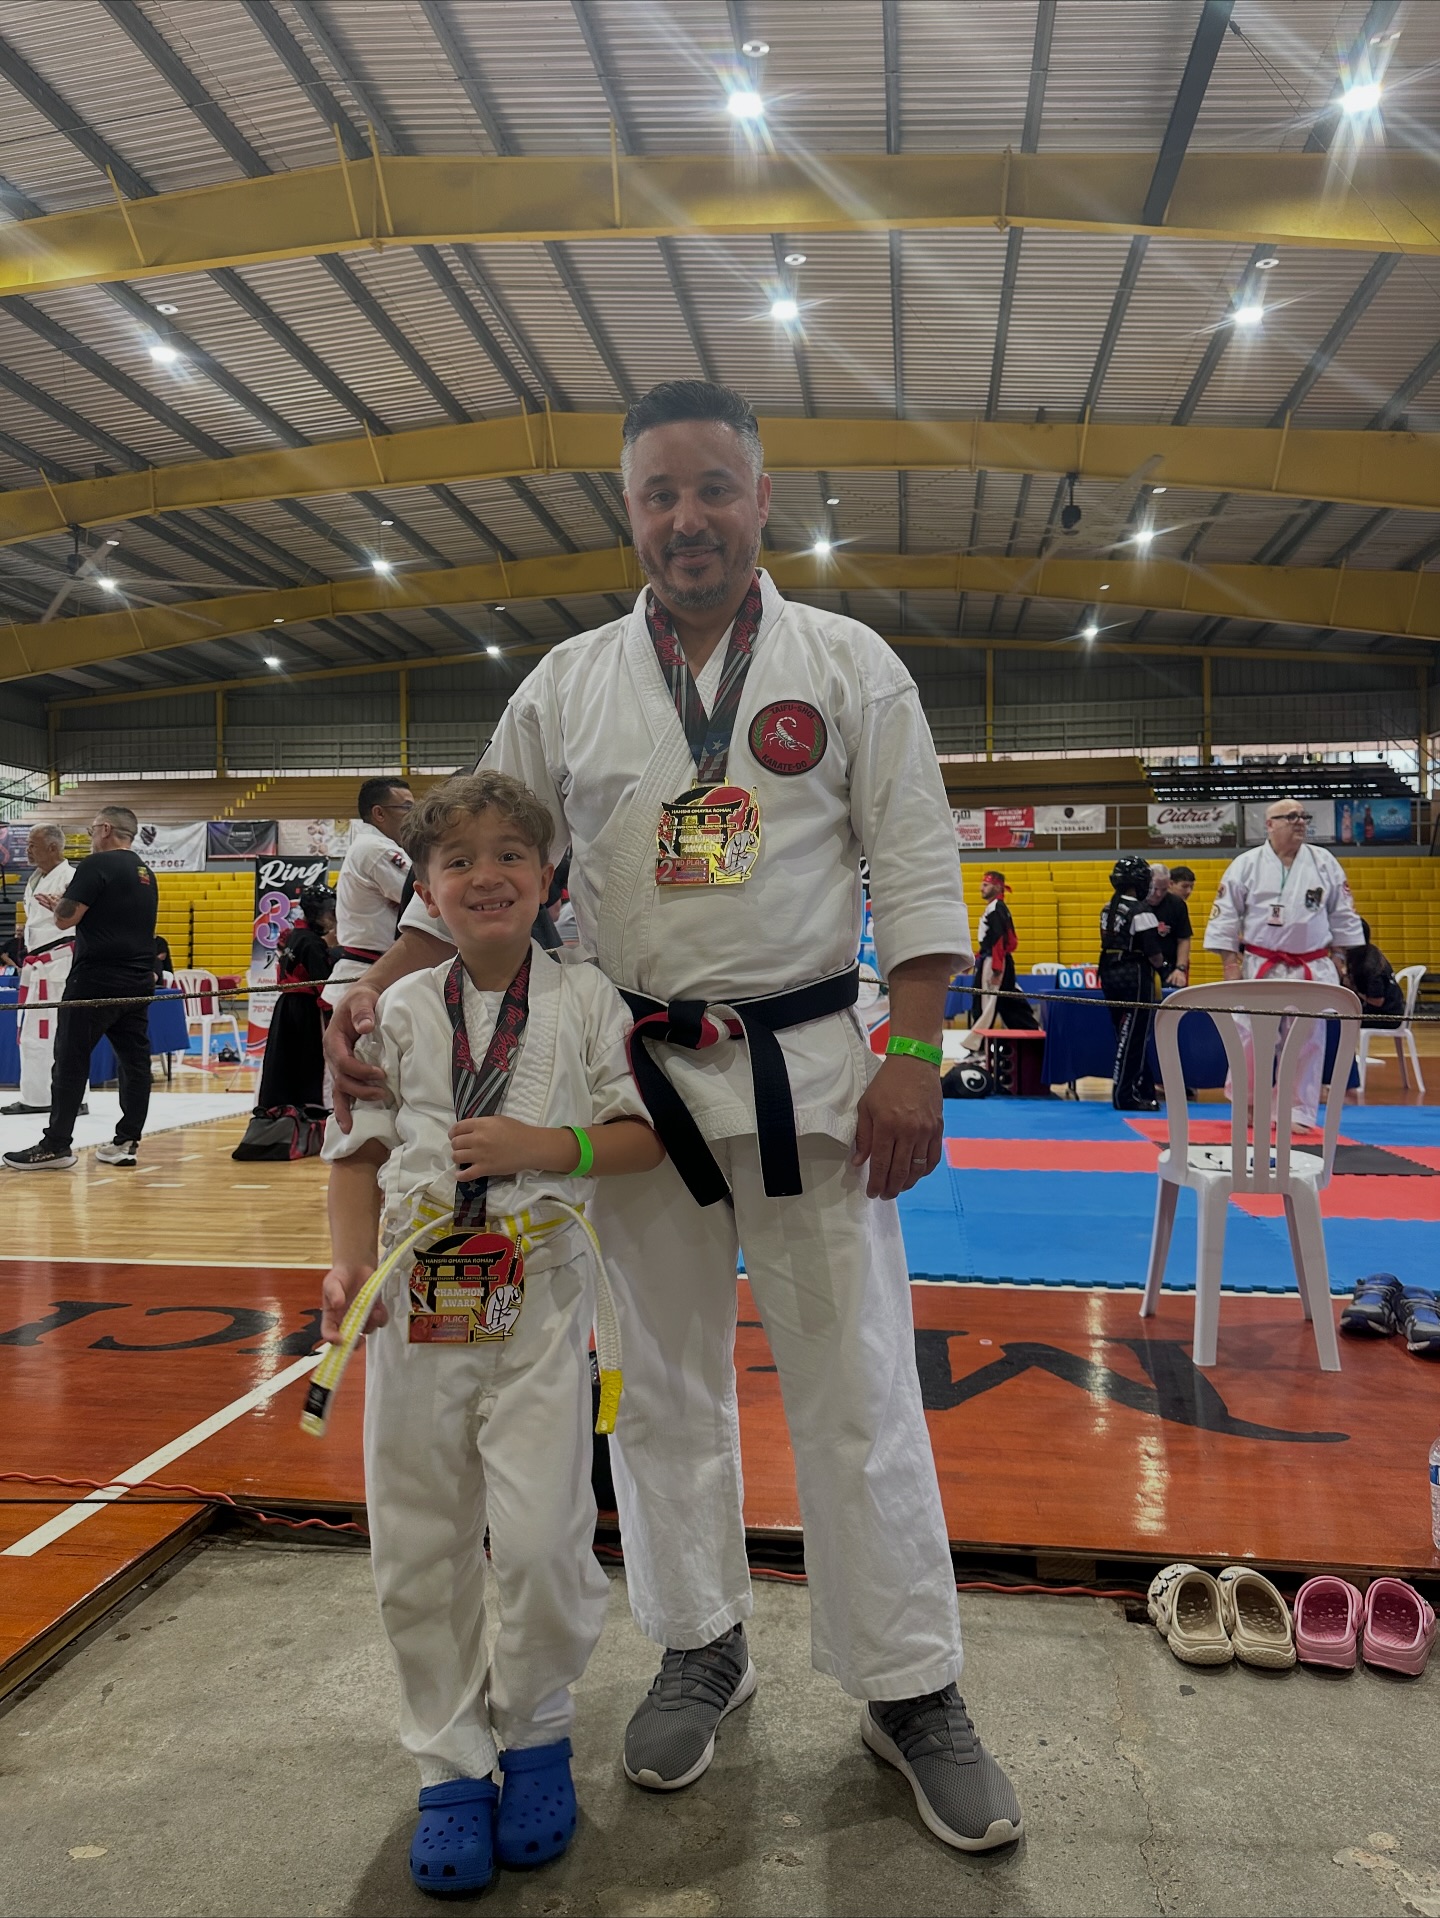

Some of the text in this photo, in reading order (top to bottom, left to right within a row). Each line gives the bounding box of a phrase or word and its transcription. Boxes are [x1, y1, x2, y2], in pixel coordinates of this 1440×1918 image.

[771, 704, 815, 719] TAIFU-SHOI
[762, 754, 807, 771] KARATE-DO
[1156, 807, 1224, 825] Cidra's
[259, 860, 328, 890] Ring
[256, 891, 291, 949] 3
[434, 1288, 485, 1297] CHAMPION
[441, 1299, 477, 1308] AWARD
